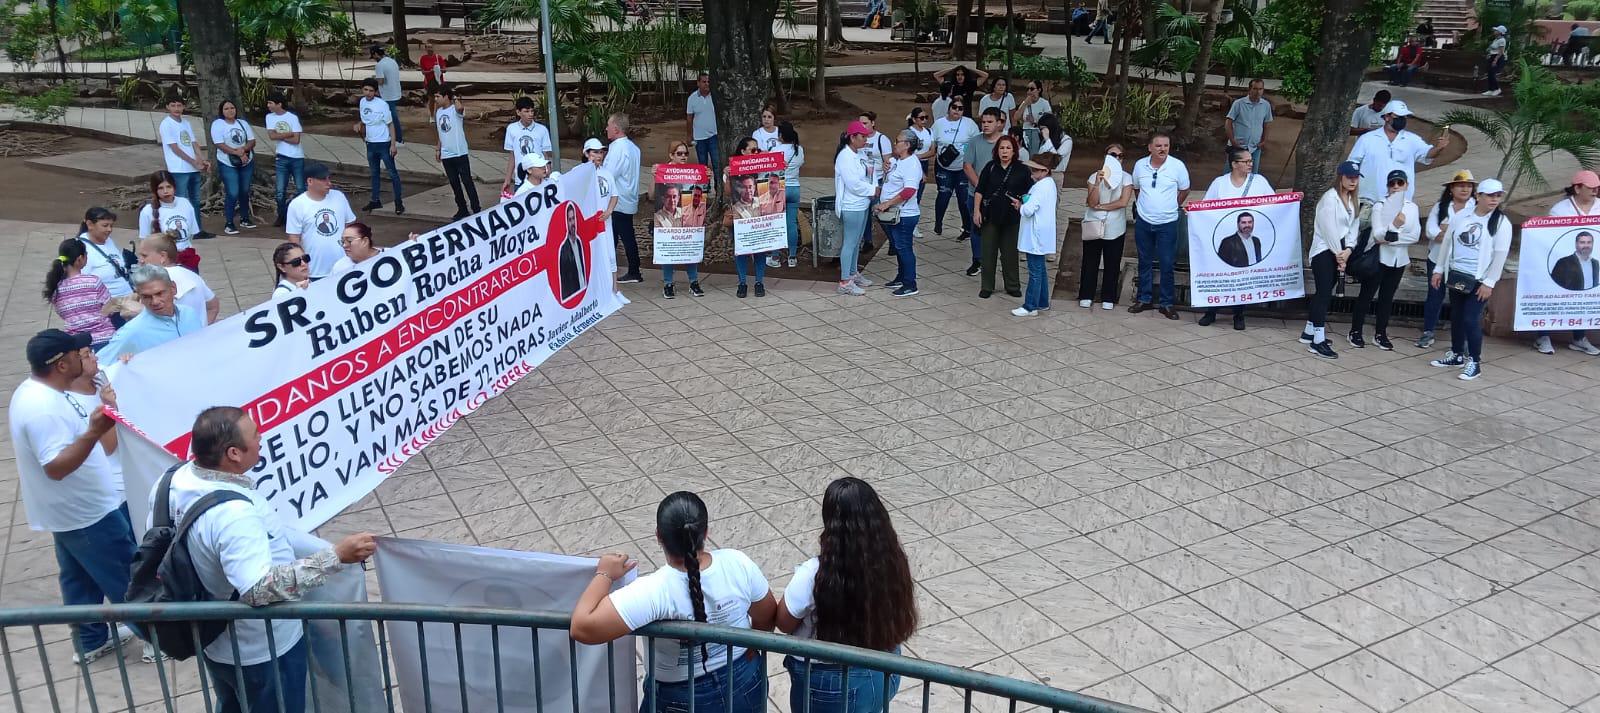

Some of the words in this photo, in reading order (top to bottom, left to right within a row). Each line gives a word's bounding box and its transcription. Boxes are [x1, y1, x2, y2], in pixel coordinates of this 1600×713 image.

[738, 163, 777, 171] ENCONTRARLO
[244, 296, 326, 348] SR.
[336, 183, 561, 304] GOBERNADOR
[306, 292, 408, 359] Ruben
[412, 253, 483, 304] Rocha
[488, 225, 540, 264] Moya
[1207, 295, 1220, 304] 66
[1224, 295, 1236, 303] 71
[1240, 293, 1253, 301] 84
[1257, 291, 1269, 299] 12
[1272, 289, 1286, 297] 56
[377, 339, 392, 364] A
[398, 254, 538, 348] ENCONTRARLO!
[547, 320, 569, 342] Javier
[569, 299, 599, 326] Adalberto
[572, 312, 603, 334] Armenta
[1531, 319, 1546, 327] 66
[1550, 318, 1563, 327] 71
[1568, 318, 1582, 327] 84
[1587, 317, 1600, 326] 12
[252, 433, 285, 472] SE
[294, 410, 329, 448] LO
[338, 335, 451, 422] LLEVARON
[454, 319, 473, 348] DE
[478, 304, 498, 331] SU
[345, 418, 360, 445] Y
[369, 393, 404, 432] NO
[410, 332, 493, 403] SABEMOS
[497, 302, 543, 344] NADA
[288, 481, 329, 519] YA
[335, 435, 387, 486] VAN
[395, 399, 438, 447] MÁS
[443, 379, 470, 410] DE
[493, 326, 545, 375] HORAS
[402, 408, 465, 455] FAMILIA
